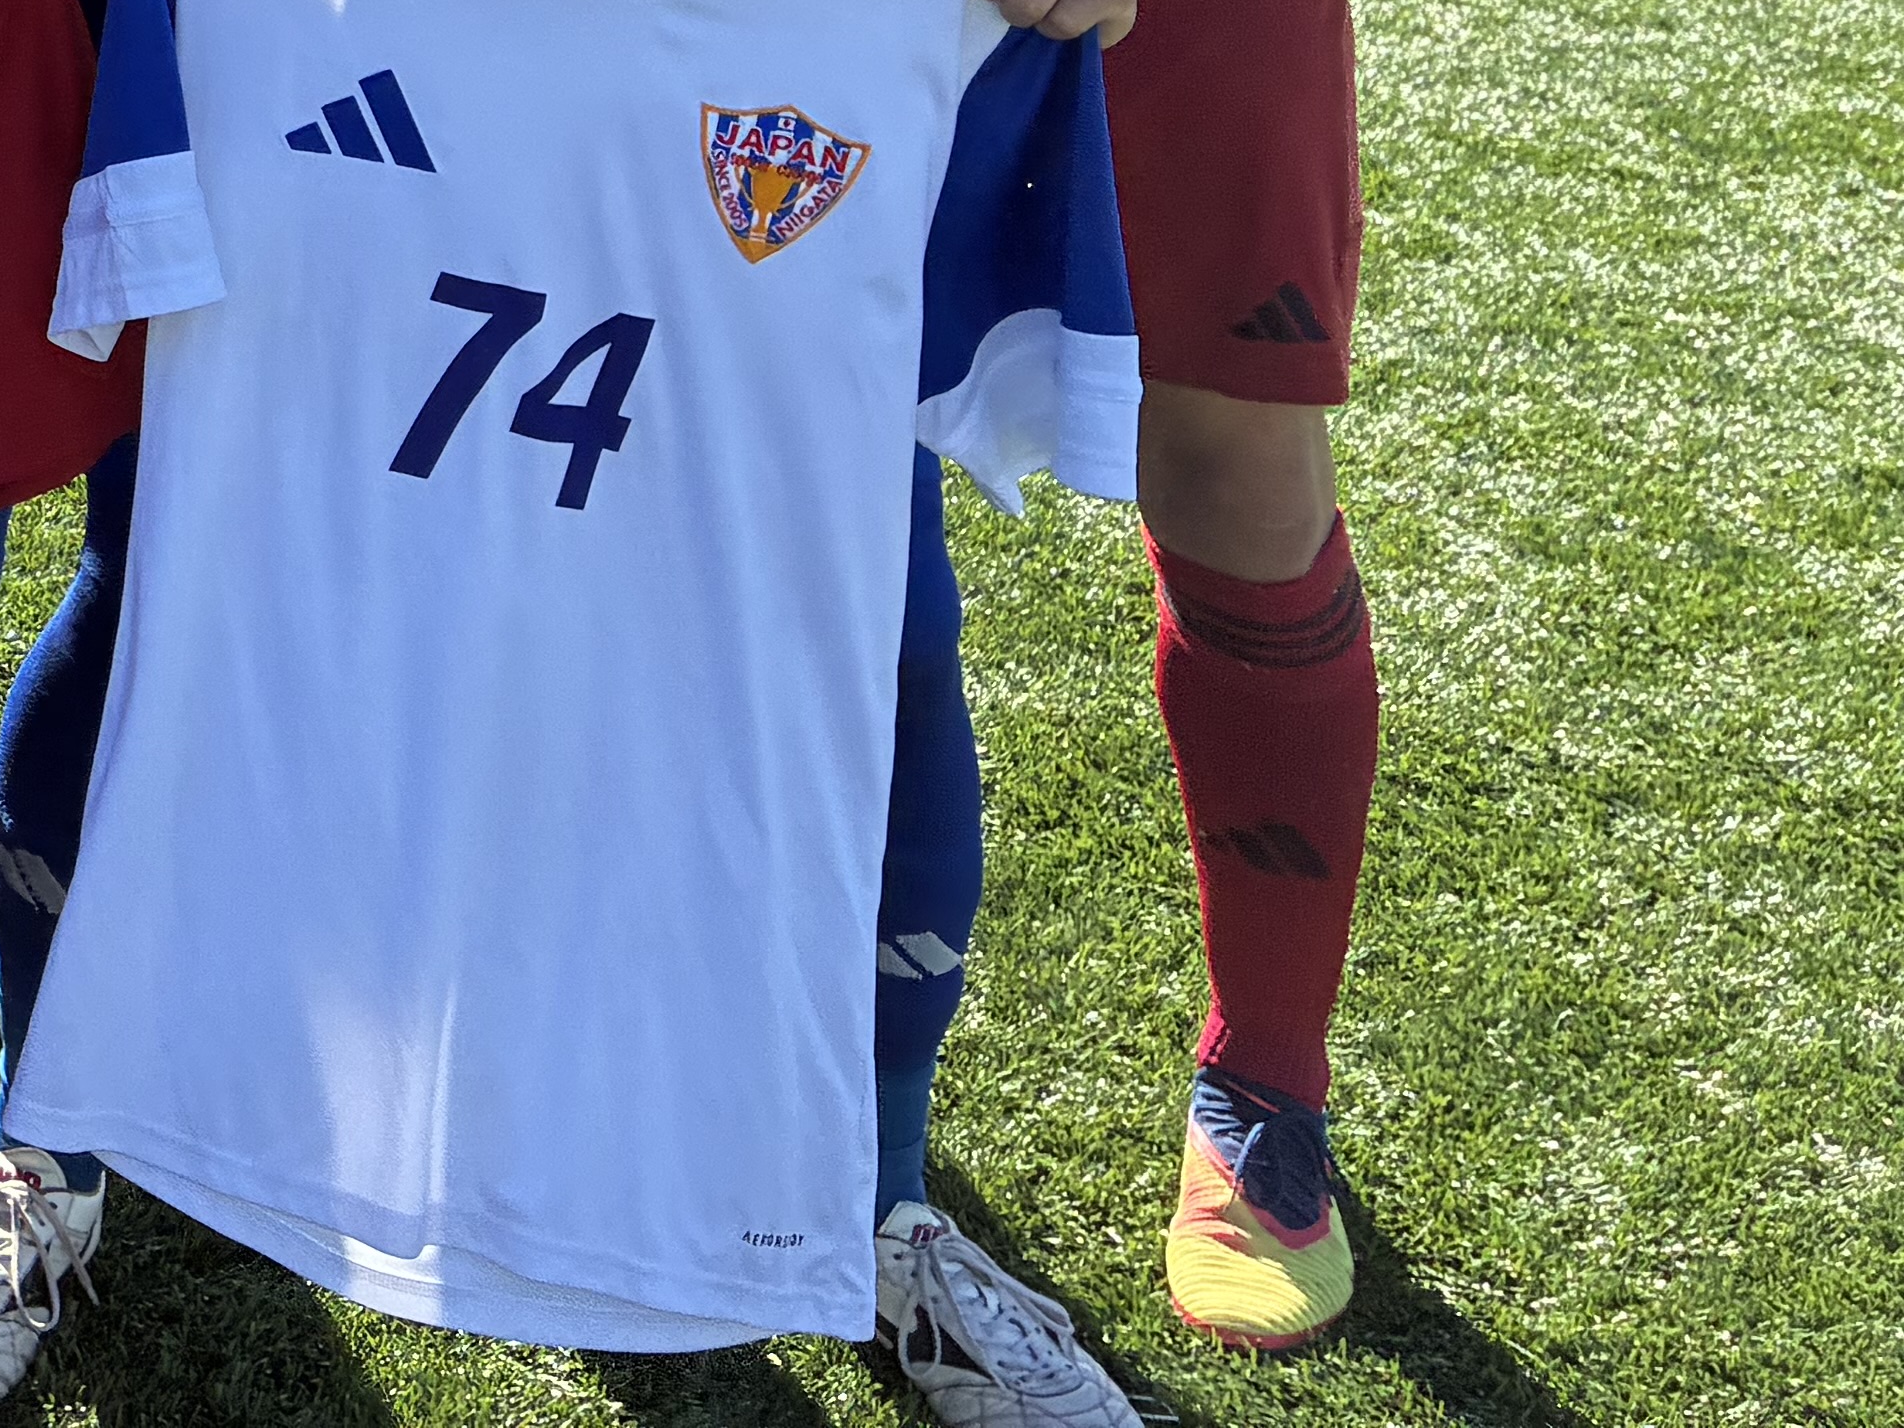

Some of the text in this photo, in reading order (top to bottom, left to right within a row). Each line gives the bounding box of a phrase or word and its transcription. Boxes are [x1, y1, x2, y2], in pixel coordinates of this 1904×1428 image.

[712, 150, 732, 191] SINCE
[715, 123, 851, 174] JAPAN
[775, 179, 842, 239] NIIGATA
[388, 272, 656, 510] 74
